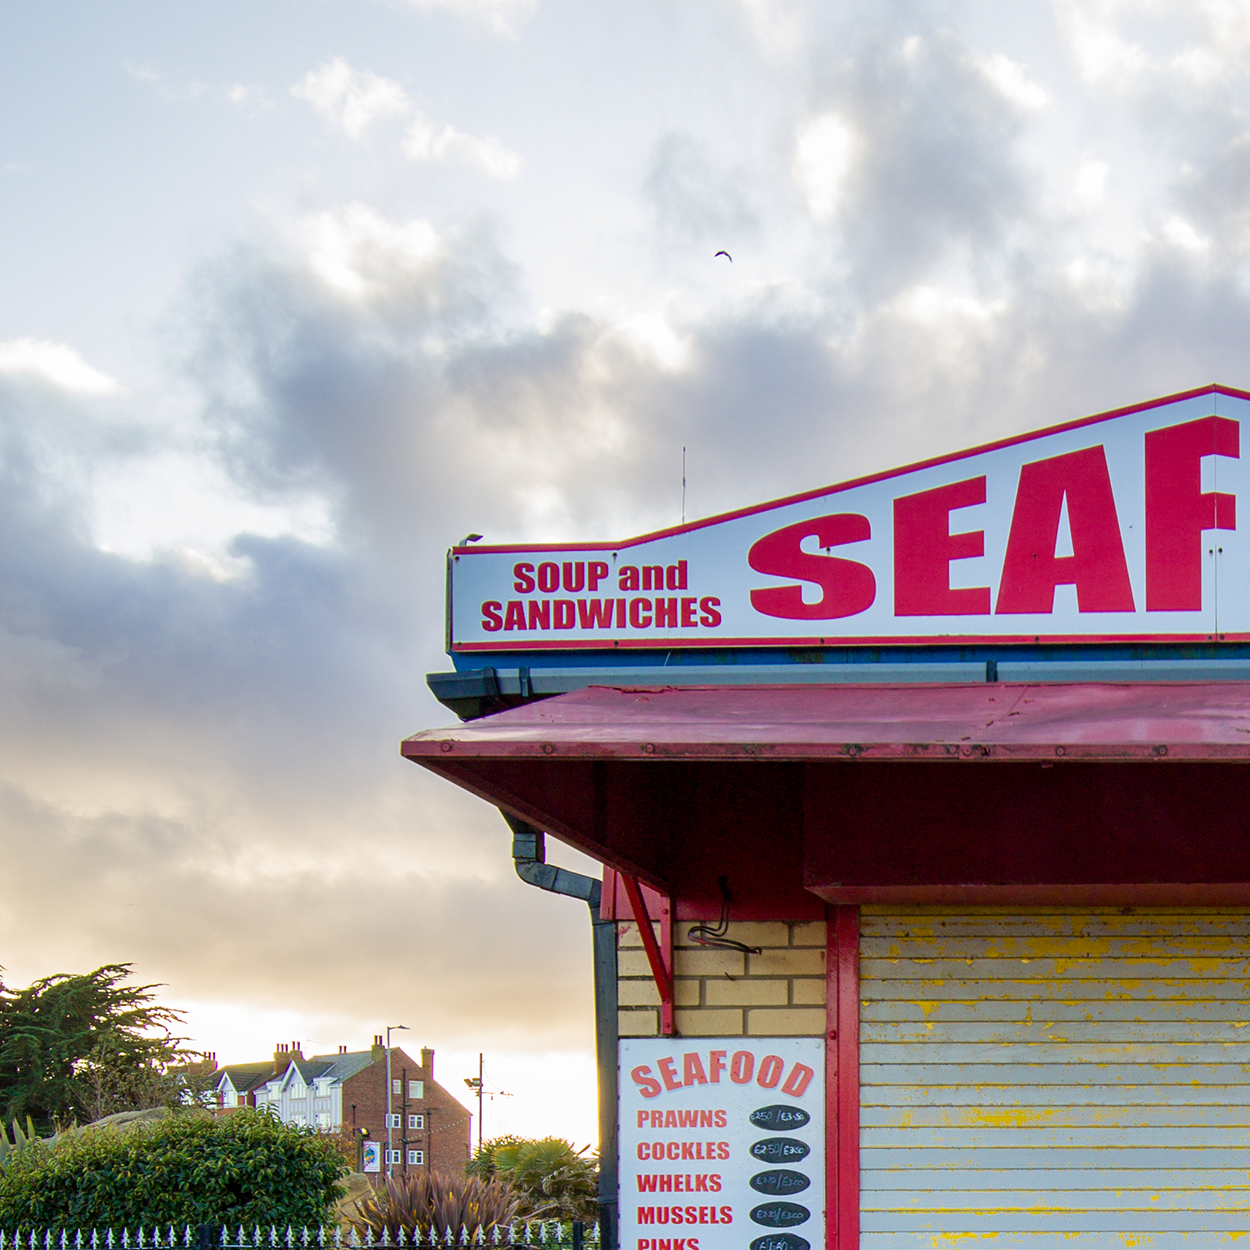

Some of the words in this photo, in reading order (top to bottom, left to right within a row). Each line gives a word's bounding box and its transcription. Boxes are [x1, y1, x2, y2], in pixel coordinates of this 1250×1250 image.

[513, 560, 608, 593] SOUP
[618, 560, 688, 591] and
[481, 596, 722, 632] SANDWICHES
[630, 1050, 814, 1098] SEAFOOD
[637, 1109, 727, 1128] PRAWNS
[637, 1142, 730, 1160] COCKLES
[636, 1174, 722, 1192] WHELKS
[637, 1206, 733, 1224] MUSSELS
